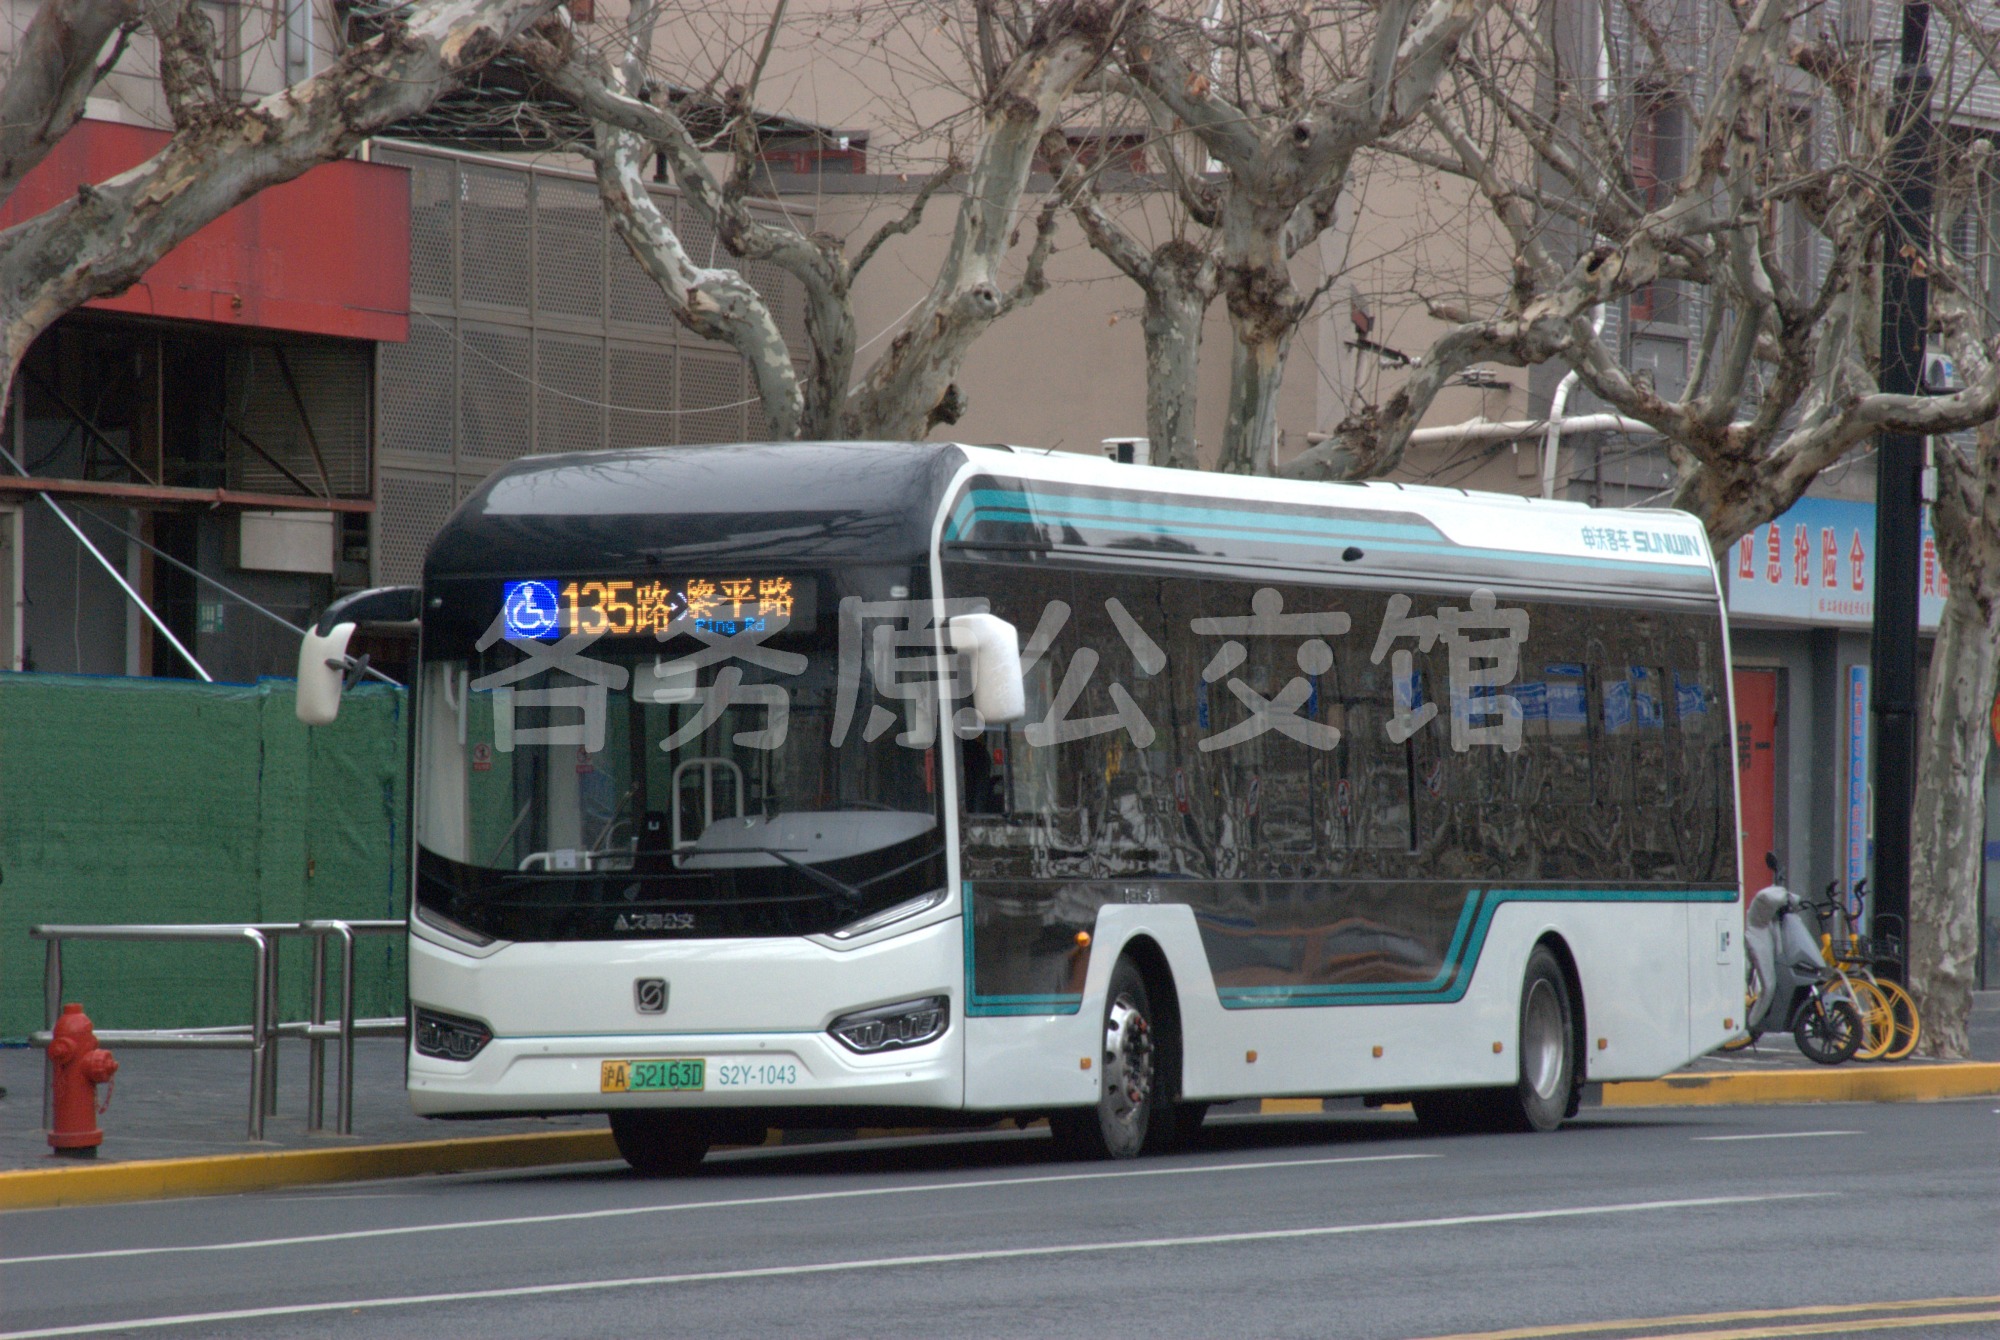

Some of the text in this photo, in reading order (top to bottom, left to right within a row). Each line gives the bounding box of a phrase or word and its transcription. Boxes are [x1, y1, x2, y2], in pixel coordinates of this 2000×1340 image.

[1581, 526, 1700, 556] 申沃客车 SUNWIN
[562, 577, 793, 634] 135路 黎平路
[744, 618, 765, 632] Rd
[719, 1065, 796, 1085] S2Y-1043
